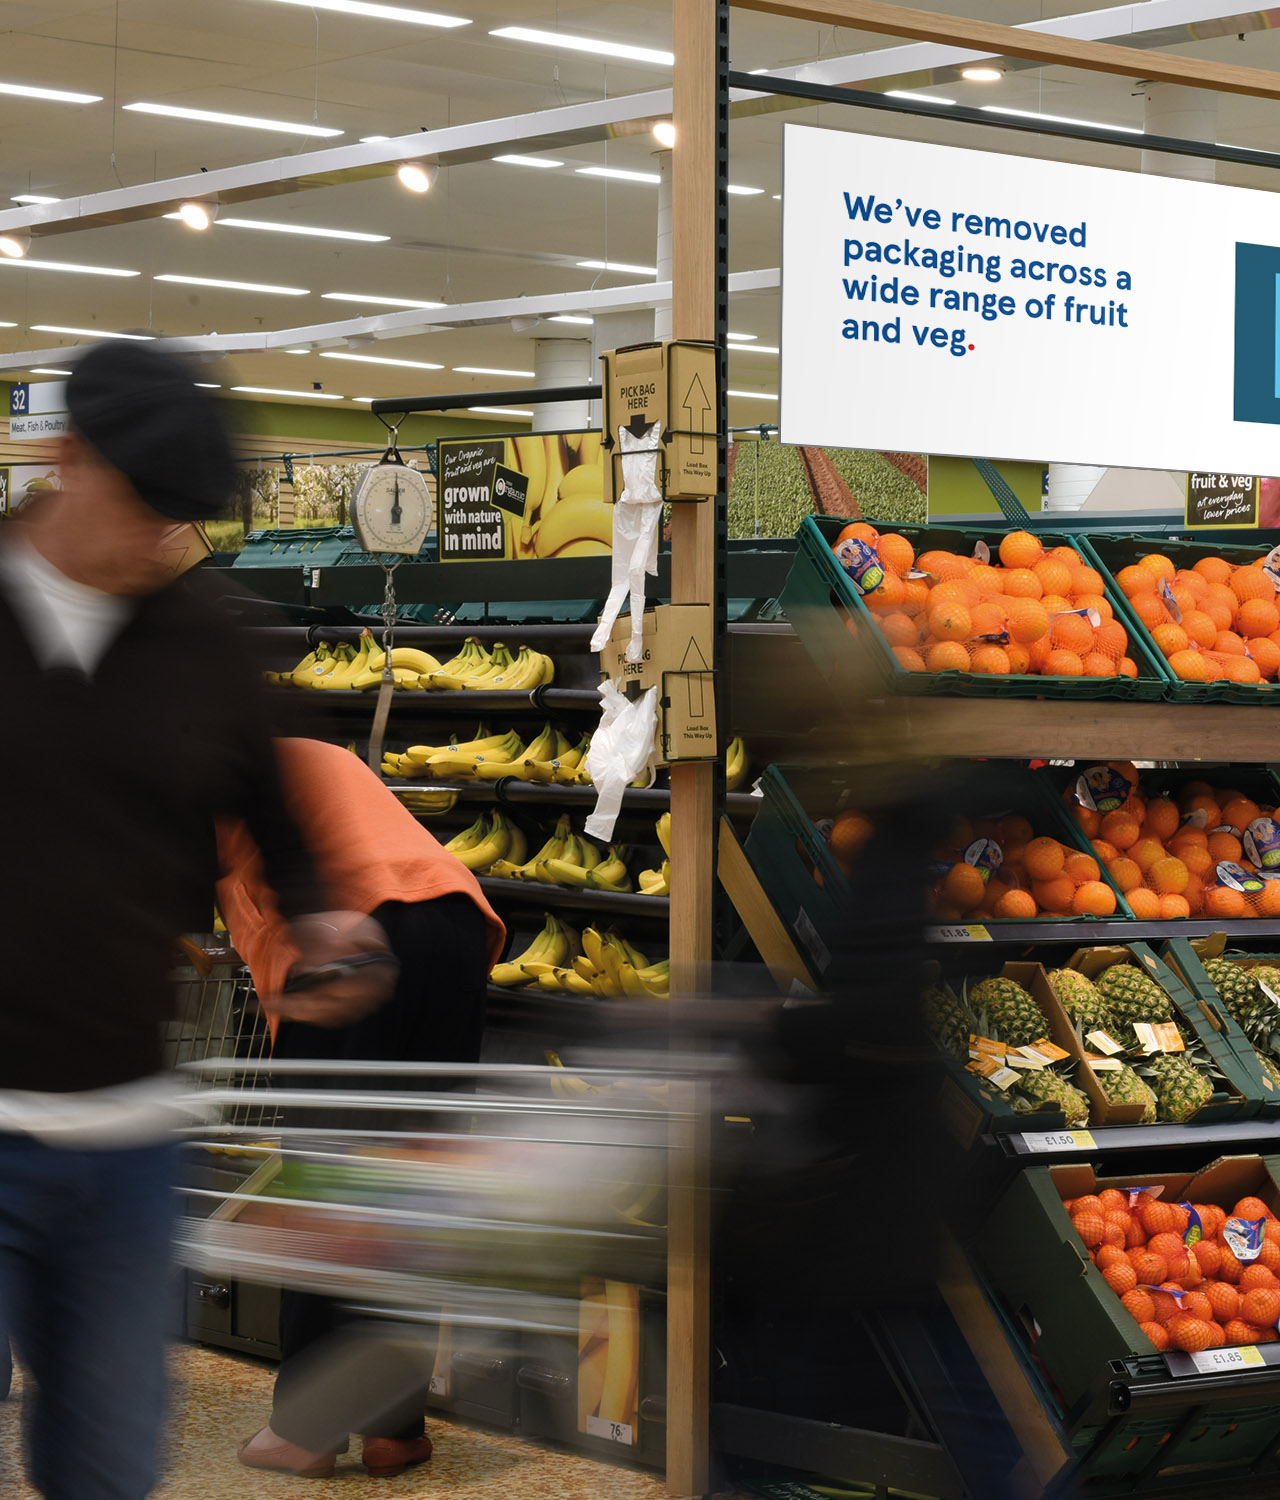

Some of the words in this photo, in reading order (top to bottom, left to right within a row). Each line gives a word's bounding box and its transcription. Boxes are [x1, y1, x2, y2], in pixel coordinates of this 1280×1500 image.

[951, 211, 1087, 248] removed
[843, 238, 1002, 283] packaging
[1010, 258, 1107, 288] across
[1116, 269, 1132, 290] a
[842, 274, 920, 306] wide
[930, 287, 1016, 321] range
[1025, 293, 1056, 320] of
[1064, 295, 1129, 328] fruit
[841, 316, 901, 344] and
[912, 325, 975, 357] veg.
[12, 389, 26, 410] 32
[620, 385, 639, 399] PICK
[639, 383, 656, 396] BAG
[627, 396, 649, 410] HERE
[11, 422, 26, 433] Meat,
[27, 421, 39, 432] Fish
[39, 421, 44, 431] &
[44, 419, 65, 432] Poultry
[444, 453, 457, 466] Our
[458, 447, 485, 466] Organic
[444, 465, 460, 482] fruit
[459, 464, 472, 476] and
[472, 462, 483, 476] veg
[483, 456, 496, 466] are
[1191, 473, 1216, 489] fruit
[1218, 474, 1229, 488] &
[1231, 476, 1252, 491] veg
[444, 485, 490, 508] grown
[1197, 496, 1208, 508] at
[1208, 490, 1244, 509] everyday
[444, 508, 467, 524] with
[468, 508, 501, 524] nature
[1203, 509, 1225, 520] lower
[1224, 503, 1251, 520] prices
[444, 527, 459, 551] in
[462, 525, 502, 551] mind
[617, 652, 628, 665] PIC
[623, 663, 644, 676] HERE
[940, 928, 970, 938] £1.85
[1044, 1135, 1074, 1145] £1.50
[1213, 1351, 1243, 1364] £1.85
